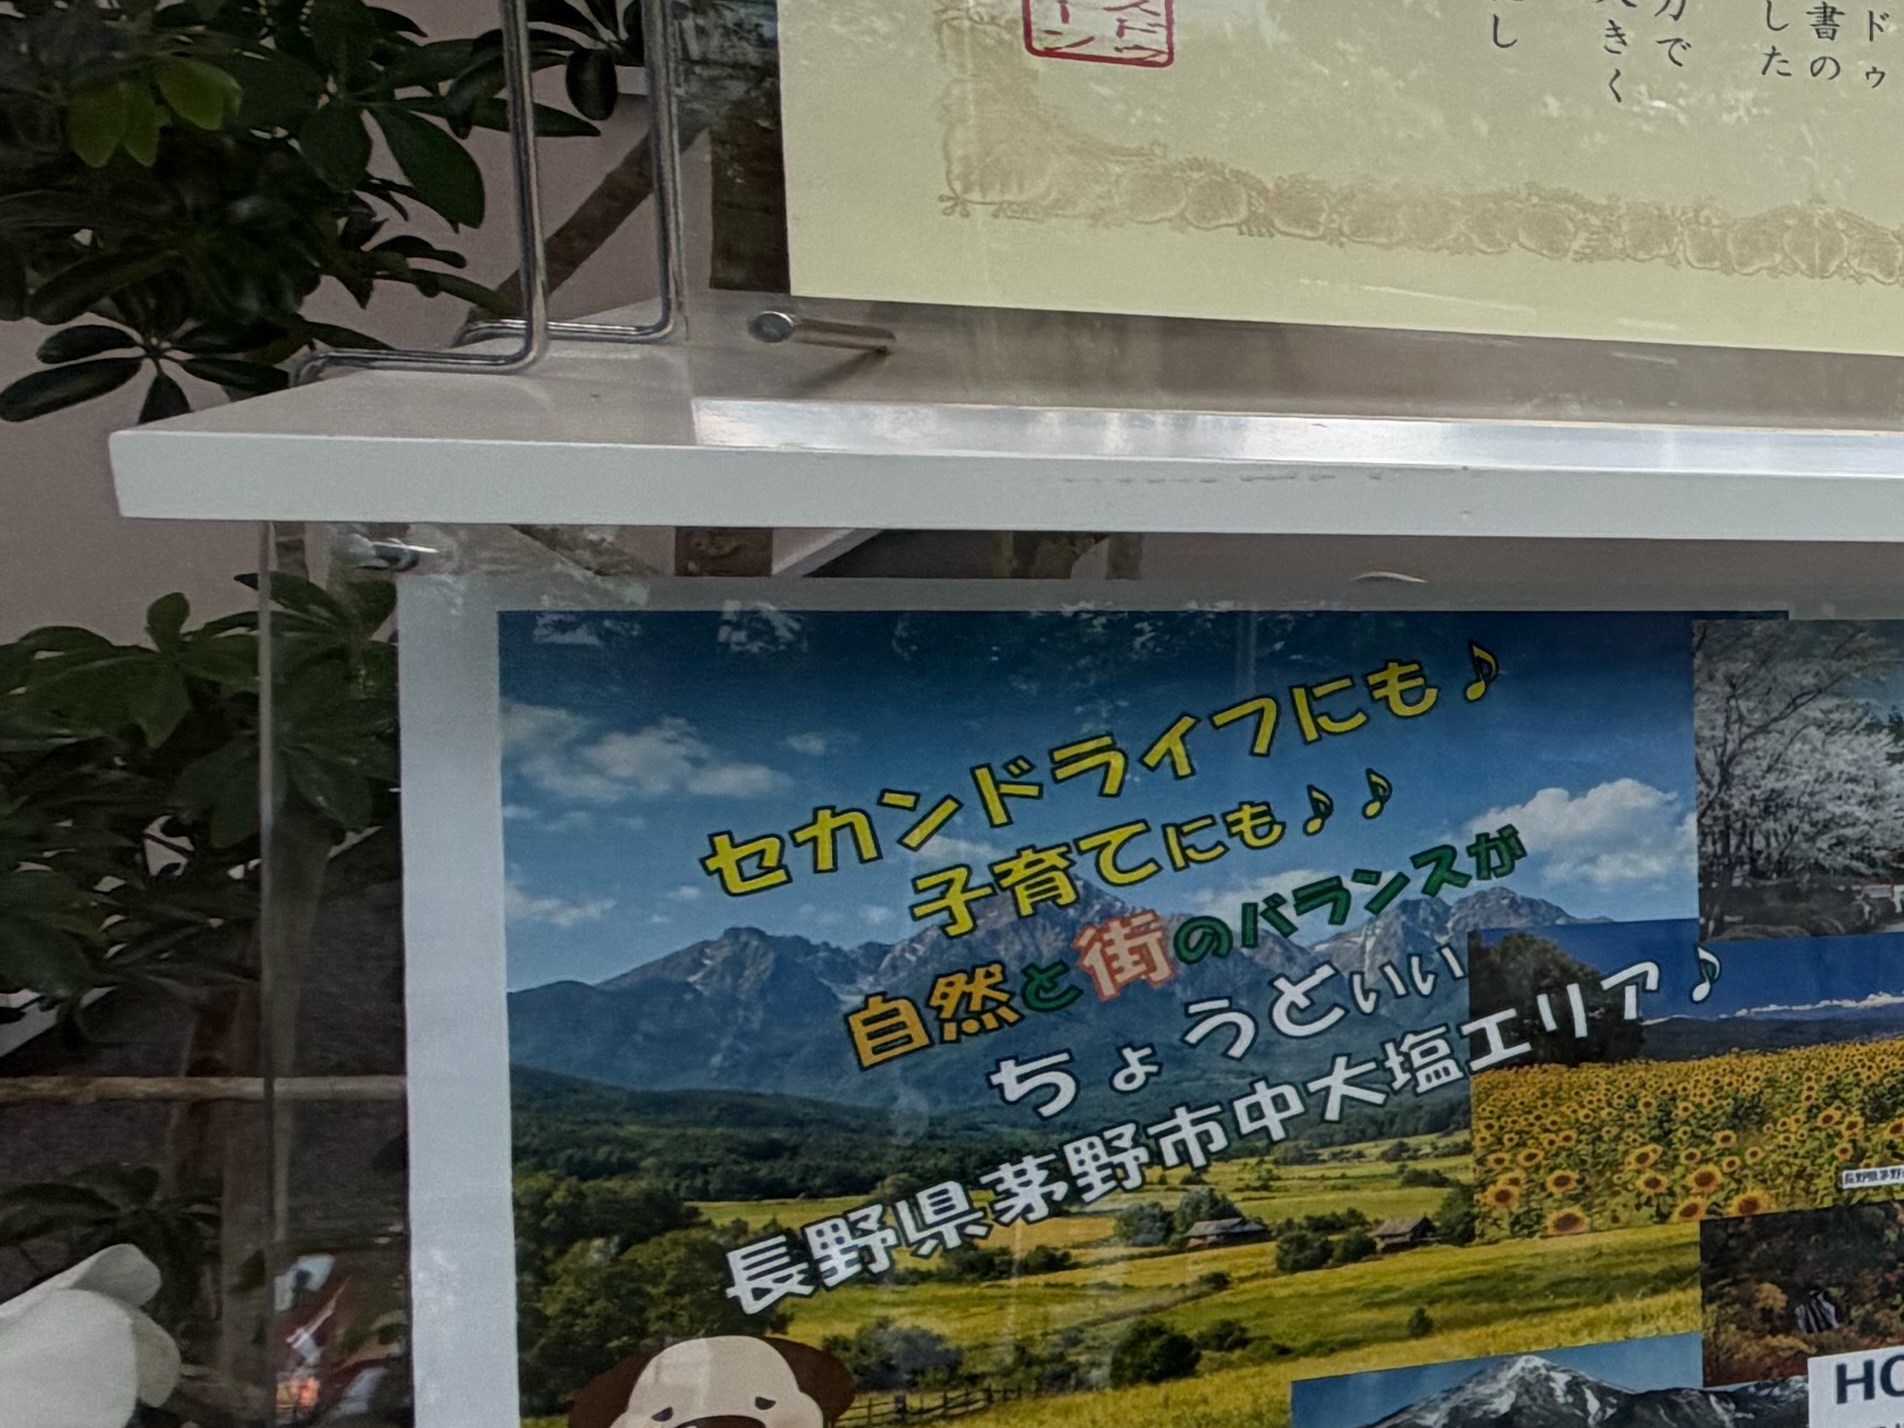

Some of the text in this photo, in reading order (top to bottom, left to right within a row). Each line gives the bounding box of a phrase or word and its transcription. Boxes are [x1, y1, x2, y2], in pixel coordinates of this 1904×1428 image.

[702, 658, 1440, 897] セカンドライフにも
[910, 801, 1286, 940] 子育てにも
[845, 822, 1529, 1070] 自然と街のバランスが
[988, 944, 1469, 1119] ちょうどいい
[725, 960, 1662, 1316] 長野県茅野市中大塩エリア
